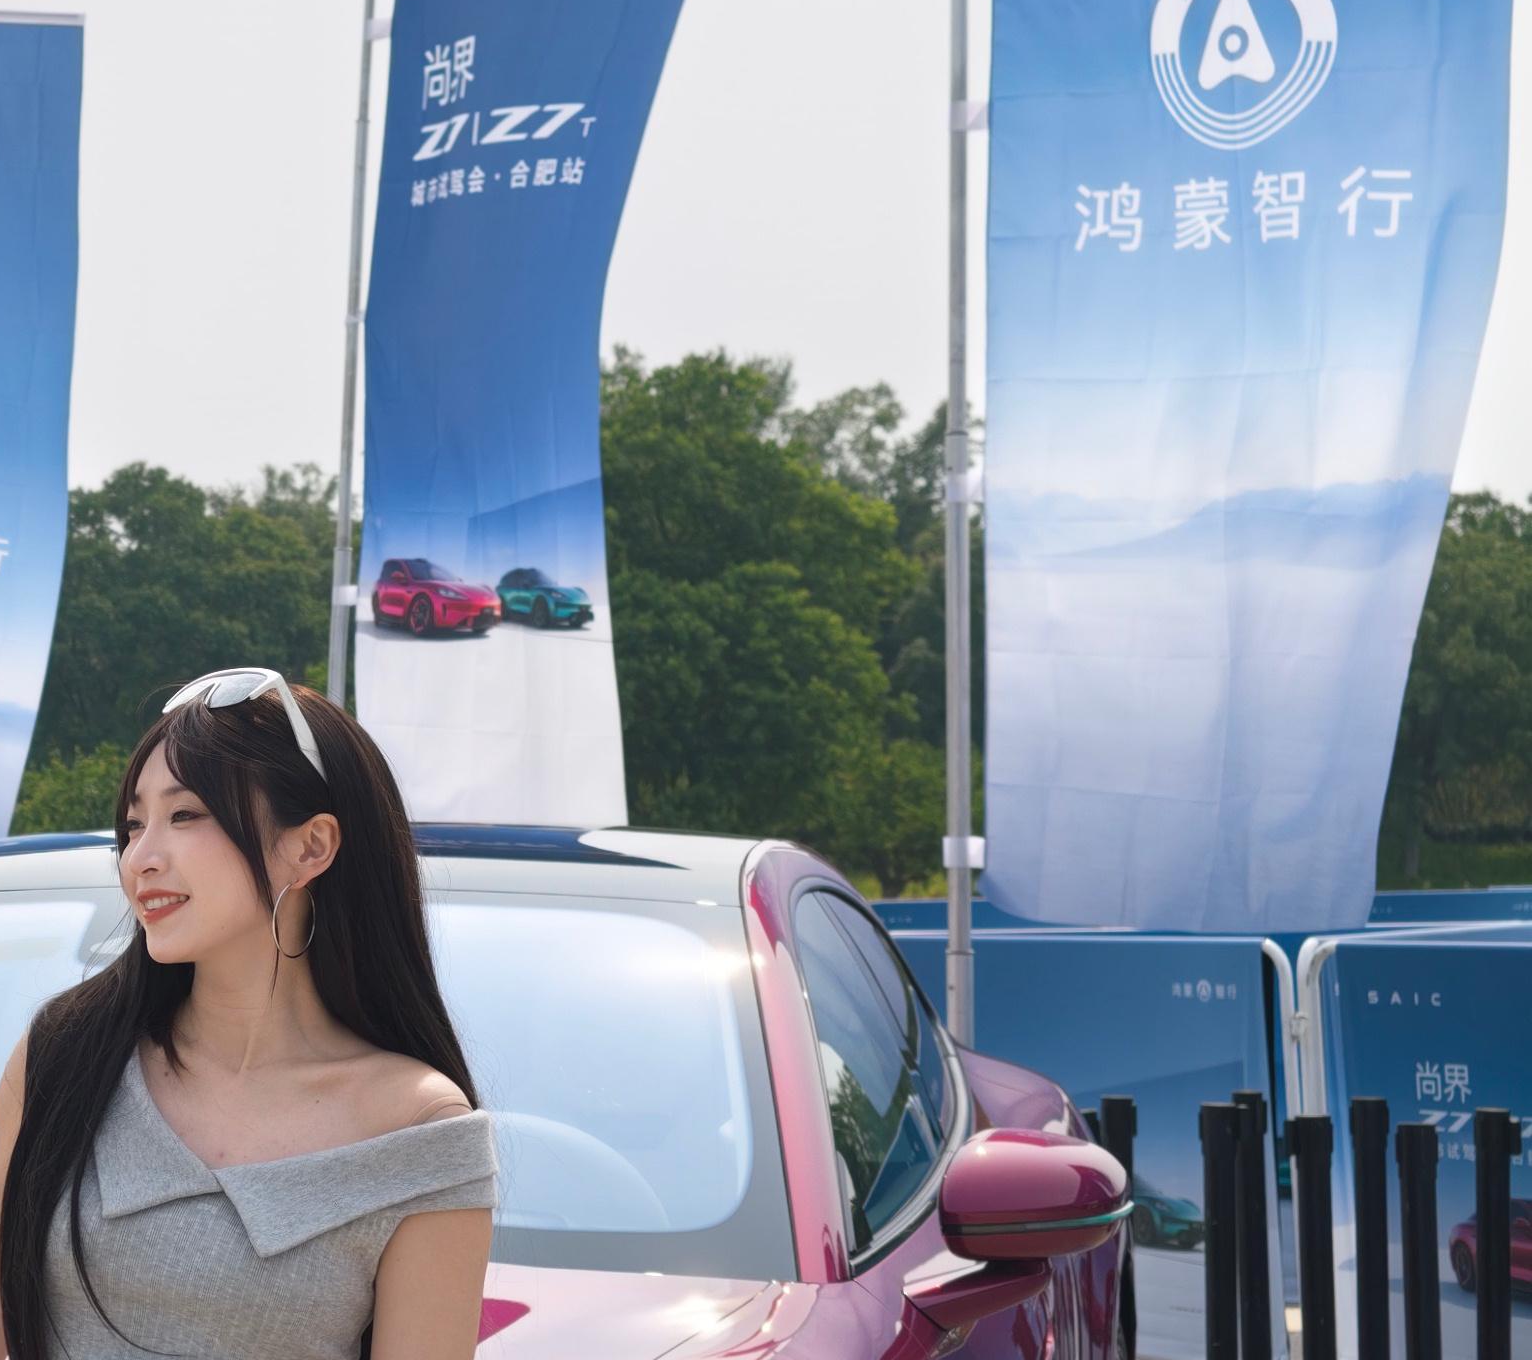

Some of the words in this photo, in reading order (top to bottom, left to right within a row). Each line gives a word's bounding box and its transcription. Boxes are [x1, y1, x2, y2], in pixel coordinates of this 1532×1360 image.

[422, 35, 476, 110] 尚界
[1074, 165, 1414, 253] 鸿蒙智行
[1368, 990, 1442, 1007] SAIC
[1415, 1060, 1472, 1105] 尚界
